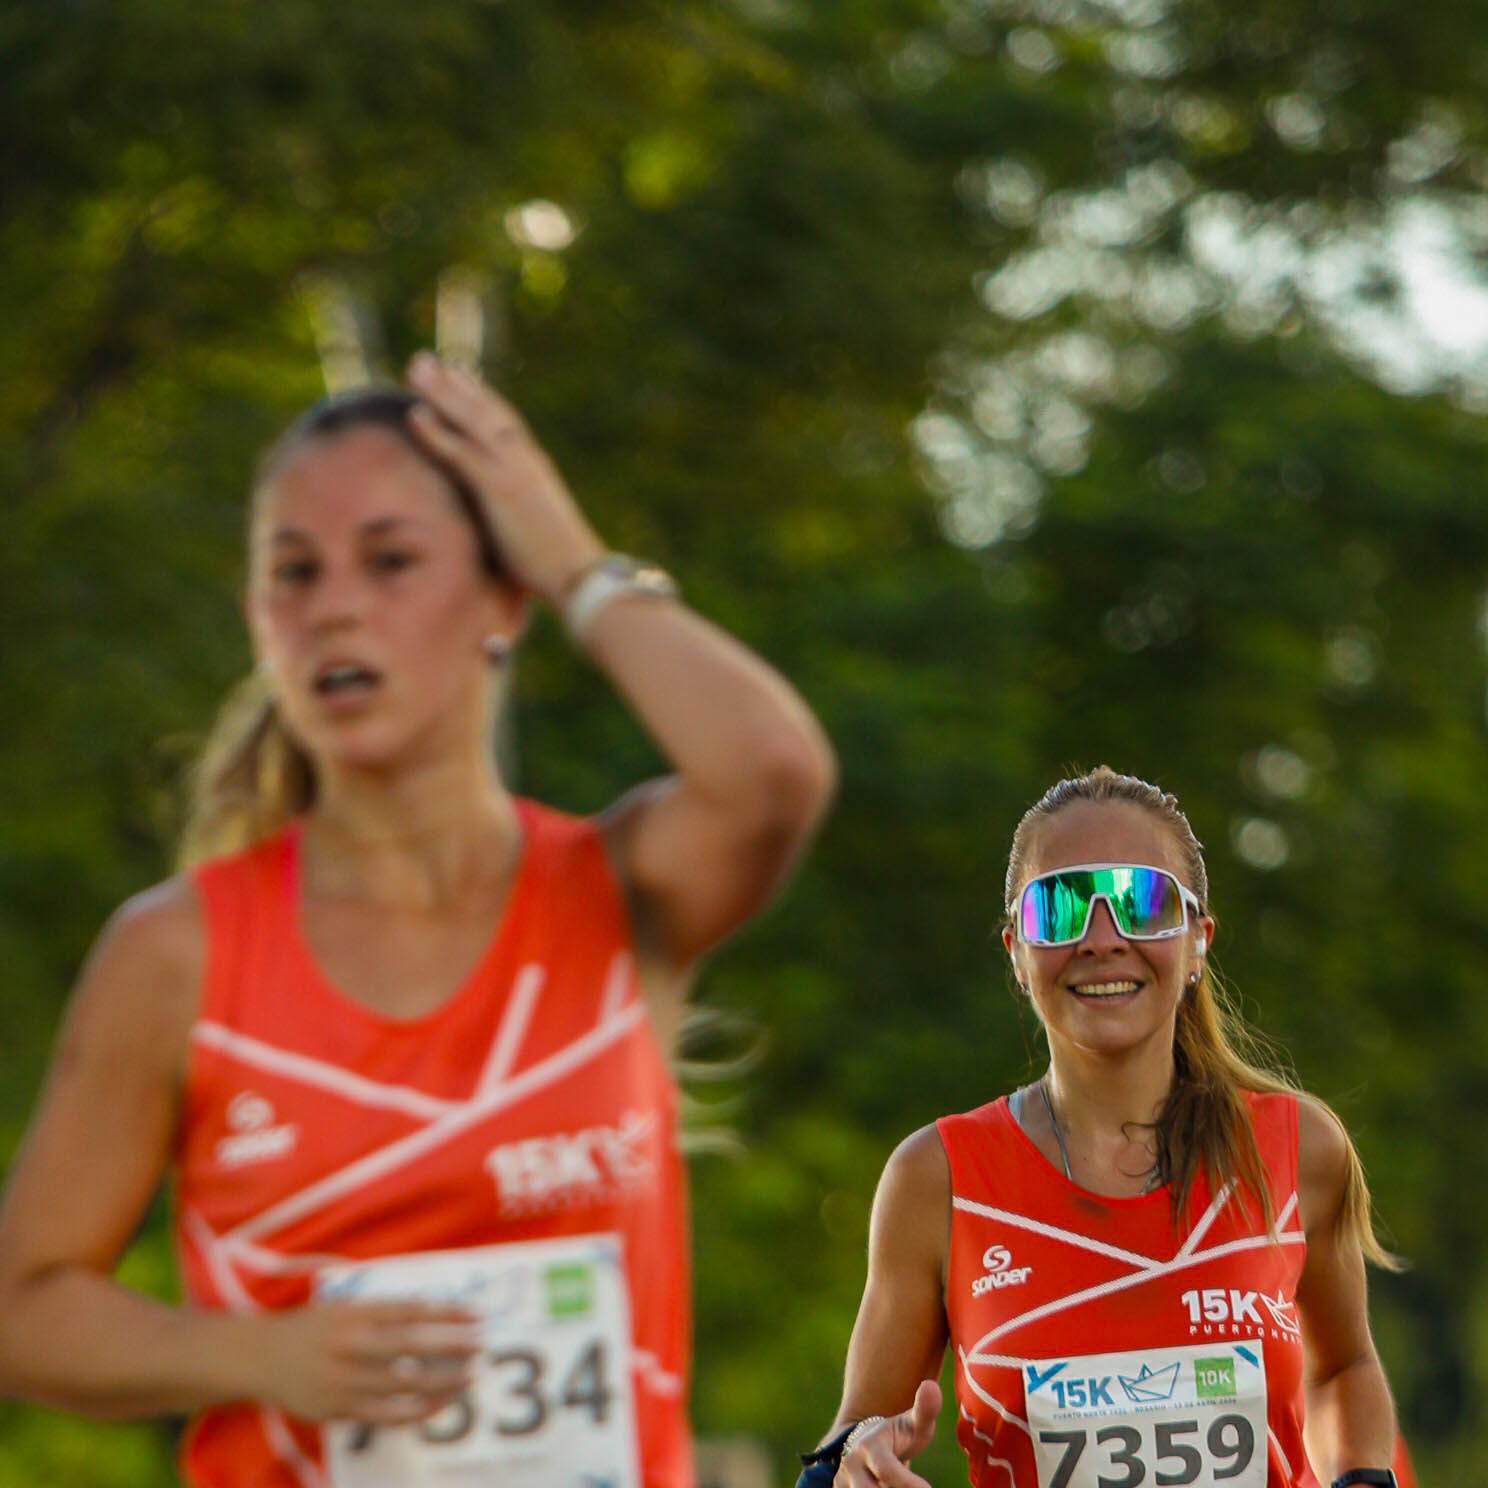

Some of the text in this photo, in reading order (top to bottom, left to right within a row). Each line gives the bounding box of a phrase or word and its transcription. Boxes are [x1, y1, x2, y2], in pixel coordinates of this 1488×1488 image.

[1181, 1288, 1264, 1325] 15K
[1189, 1323, 1265, 1338] PUERTO
[1199, 1368, 1232, 1387] 10K
[1051, 1375, 1115, 1409] 15K
